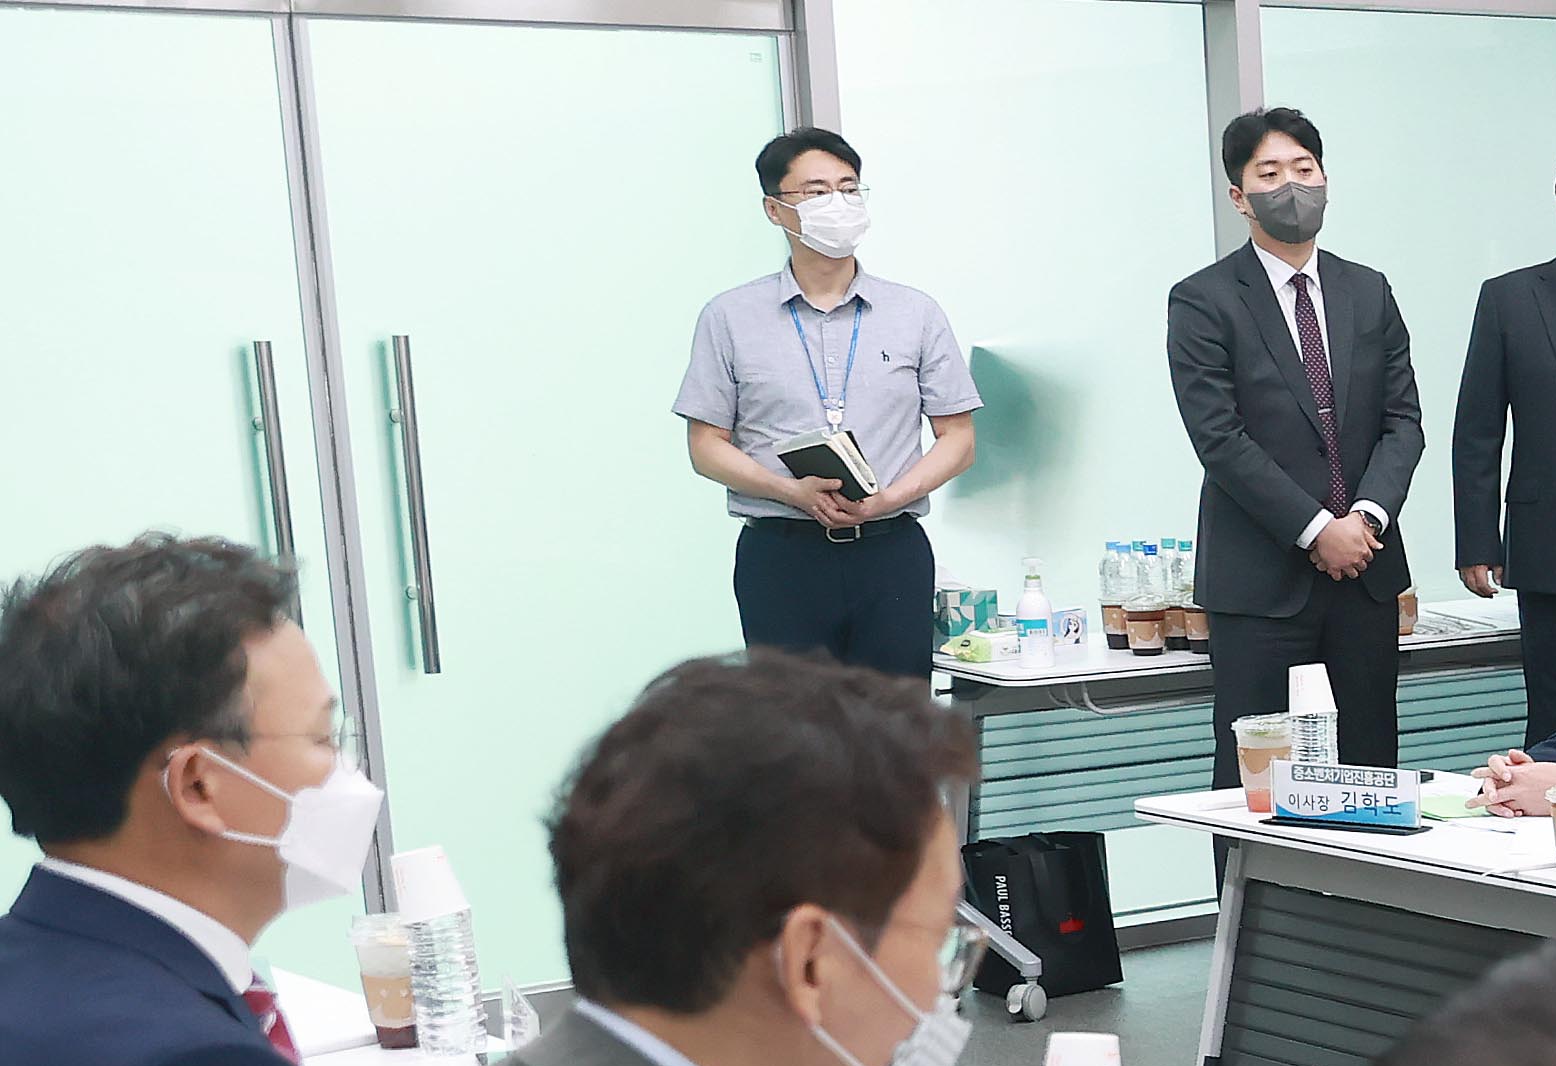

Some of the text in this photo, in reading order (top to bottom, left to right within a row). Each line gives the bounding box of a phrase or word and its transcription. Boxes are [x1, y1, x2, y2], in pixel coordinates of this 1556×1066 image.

[1293, 765, 1396, 787] 중소벤처기업진흥공단
[1288, 791, 1402, 816] 이사장 김학도
[995, 875, 1008, 902] PAUL
